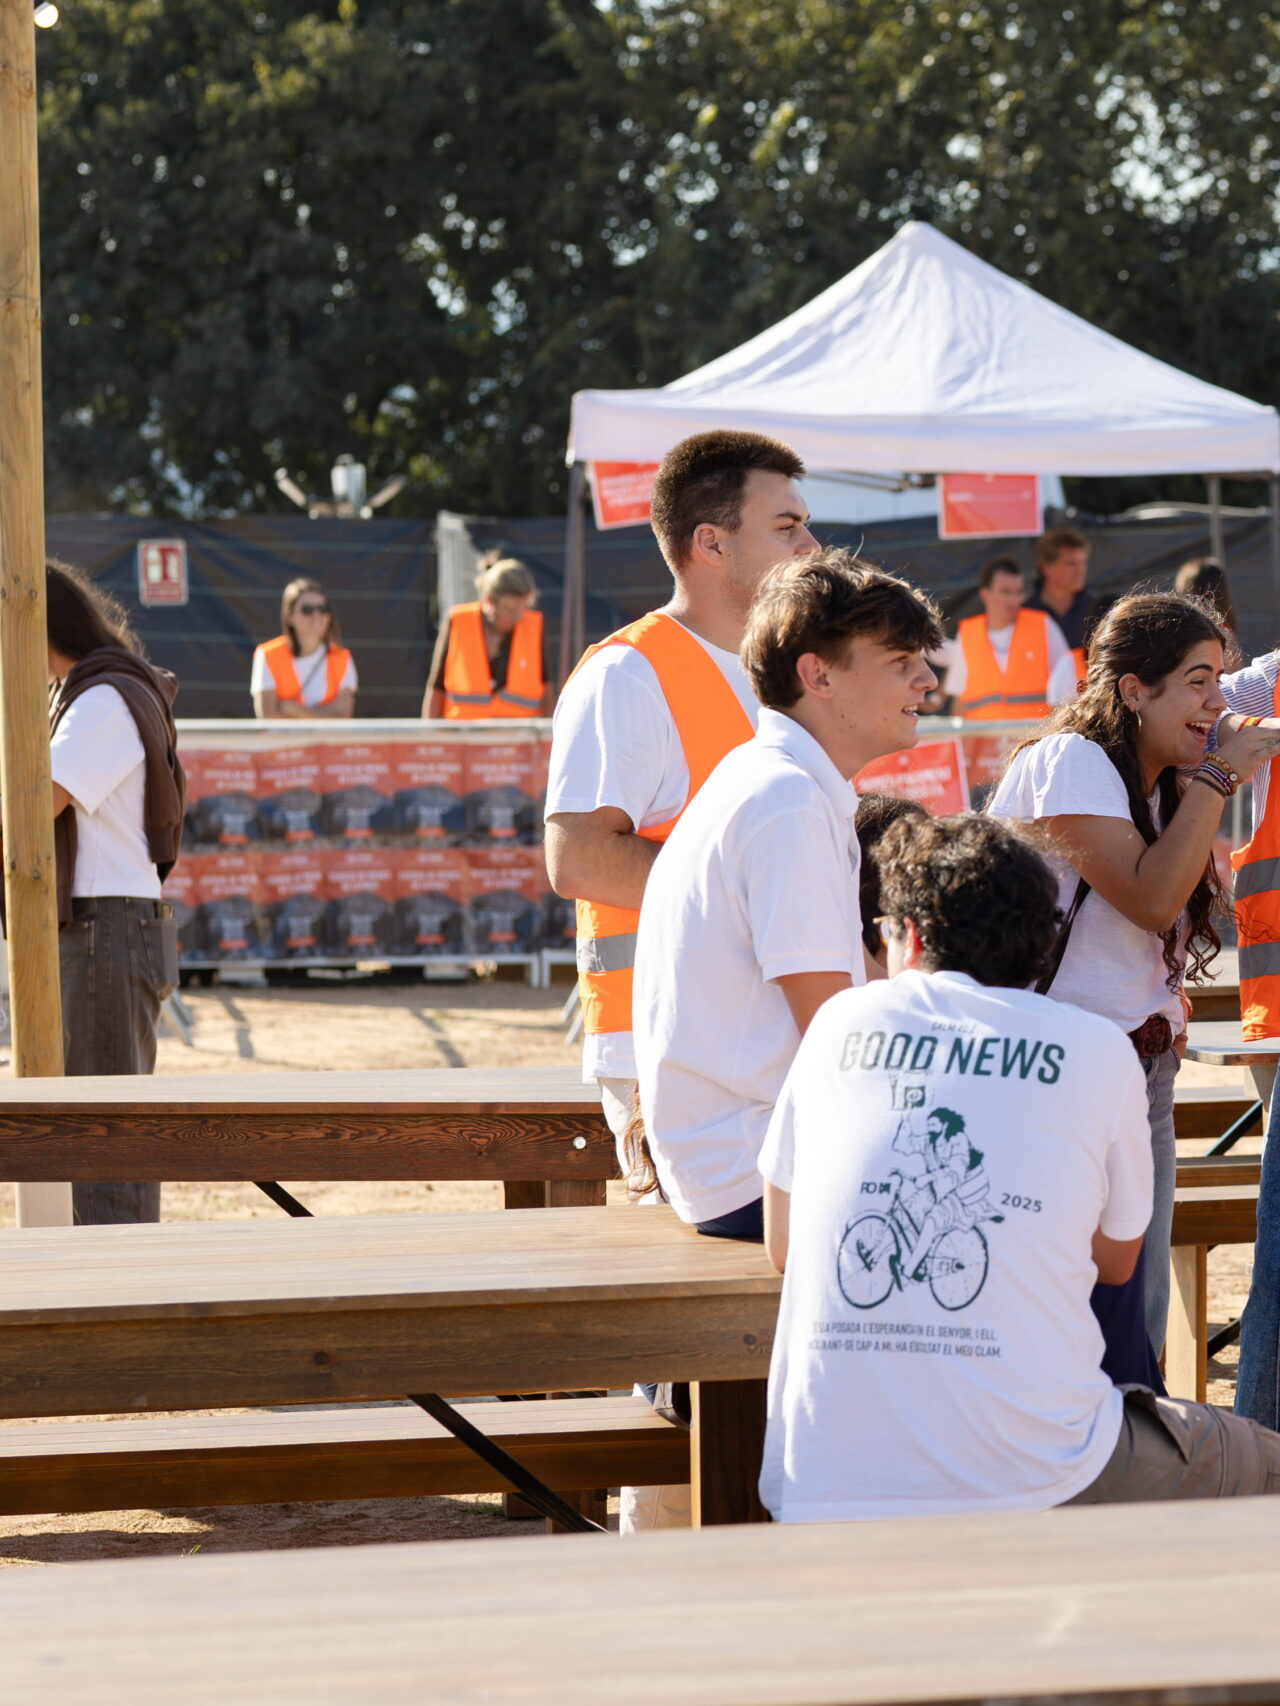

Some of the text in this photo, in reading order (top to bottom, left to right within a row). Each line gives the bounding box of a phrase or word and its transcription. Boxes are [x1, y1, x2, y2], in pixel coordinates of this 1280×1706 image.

[838, 1030, 1066, 1085] GOOD NEWS
[1000, 1192, 1043, 1213] 2025
[925, 1324, 936, 1338] EL
[855, 1339, 873, 1352] CAP
[873, 1340, 880, 1352] A
[895, 1340, 907, 1353] HA
[943, 1342, 953, 1357] EL
[954, 1343, 974, 1358] MEU
